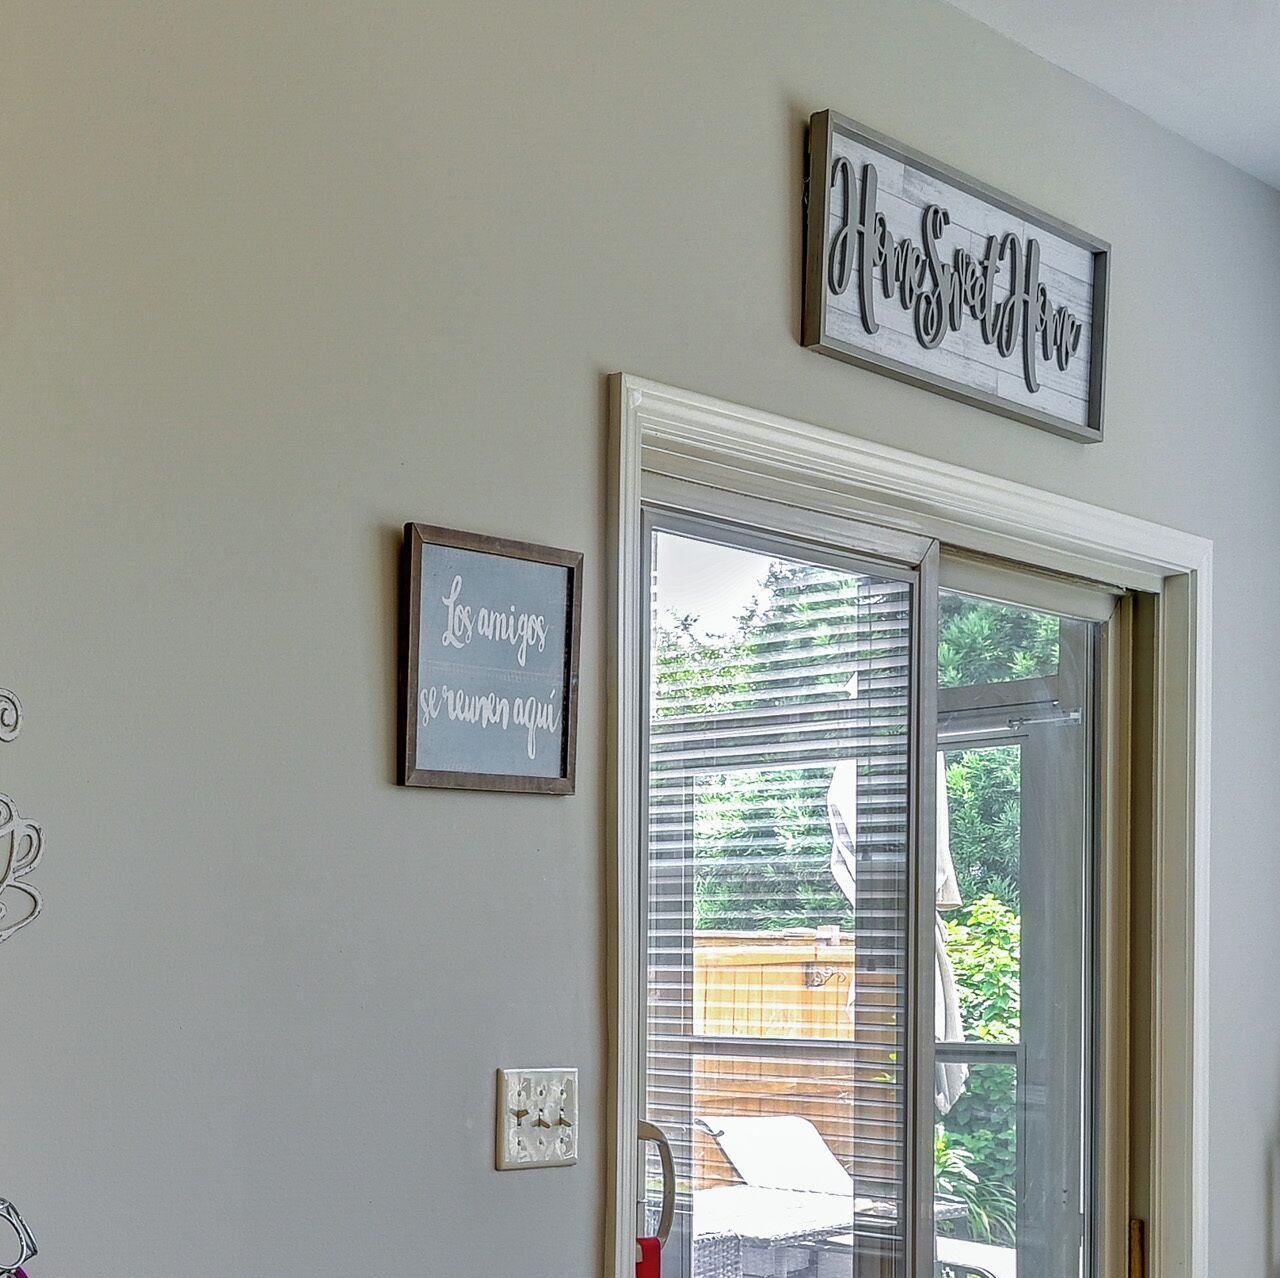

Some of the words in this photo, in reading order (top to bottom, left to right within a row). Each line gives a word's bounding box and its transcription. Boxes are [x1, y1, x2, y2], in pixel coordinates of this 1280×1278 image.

[828, 156, 926, 335] Home
[914, 204, 1000, 349] Sweet
[997, 233, 1082, 393] Home
[442, 575, 477, 648] Los
[477, 605, 550, 667] amigos
[419, 687, 442, 727] se
[513, 689, 563, 760] aquí
